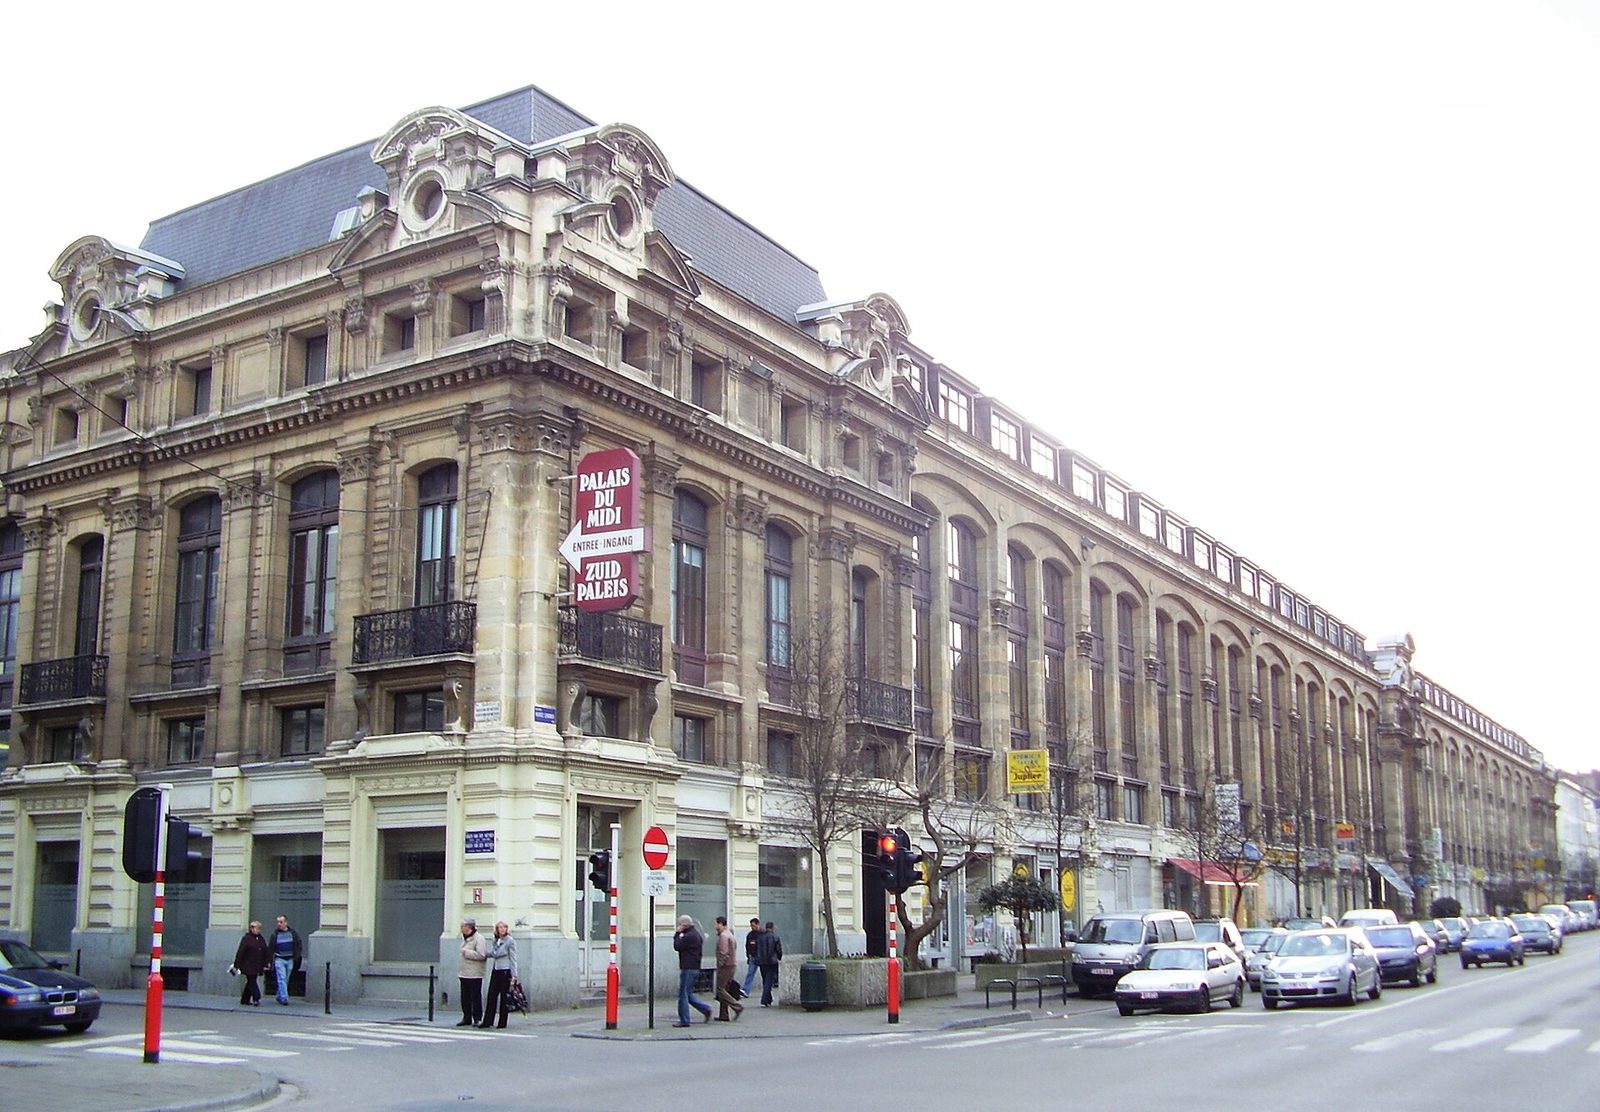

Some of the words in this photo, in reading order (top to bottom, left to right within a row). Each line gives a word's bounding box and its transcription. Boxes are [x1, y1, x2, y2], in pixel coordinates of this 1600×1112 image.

[579, 467, 630, 492] PALAIS
[594, 489, 615, 508] DU
[586, 506, 622, 528] MIDI
[603, 535, 633, 548] INGANG
[585, 560, 622, 581] ZUID
[577, 578, 629, 602] PALEIS
